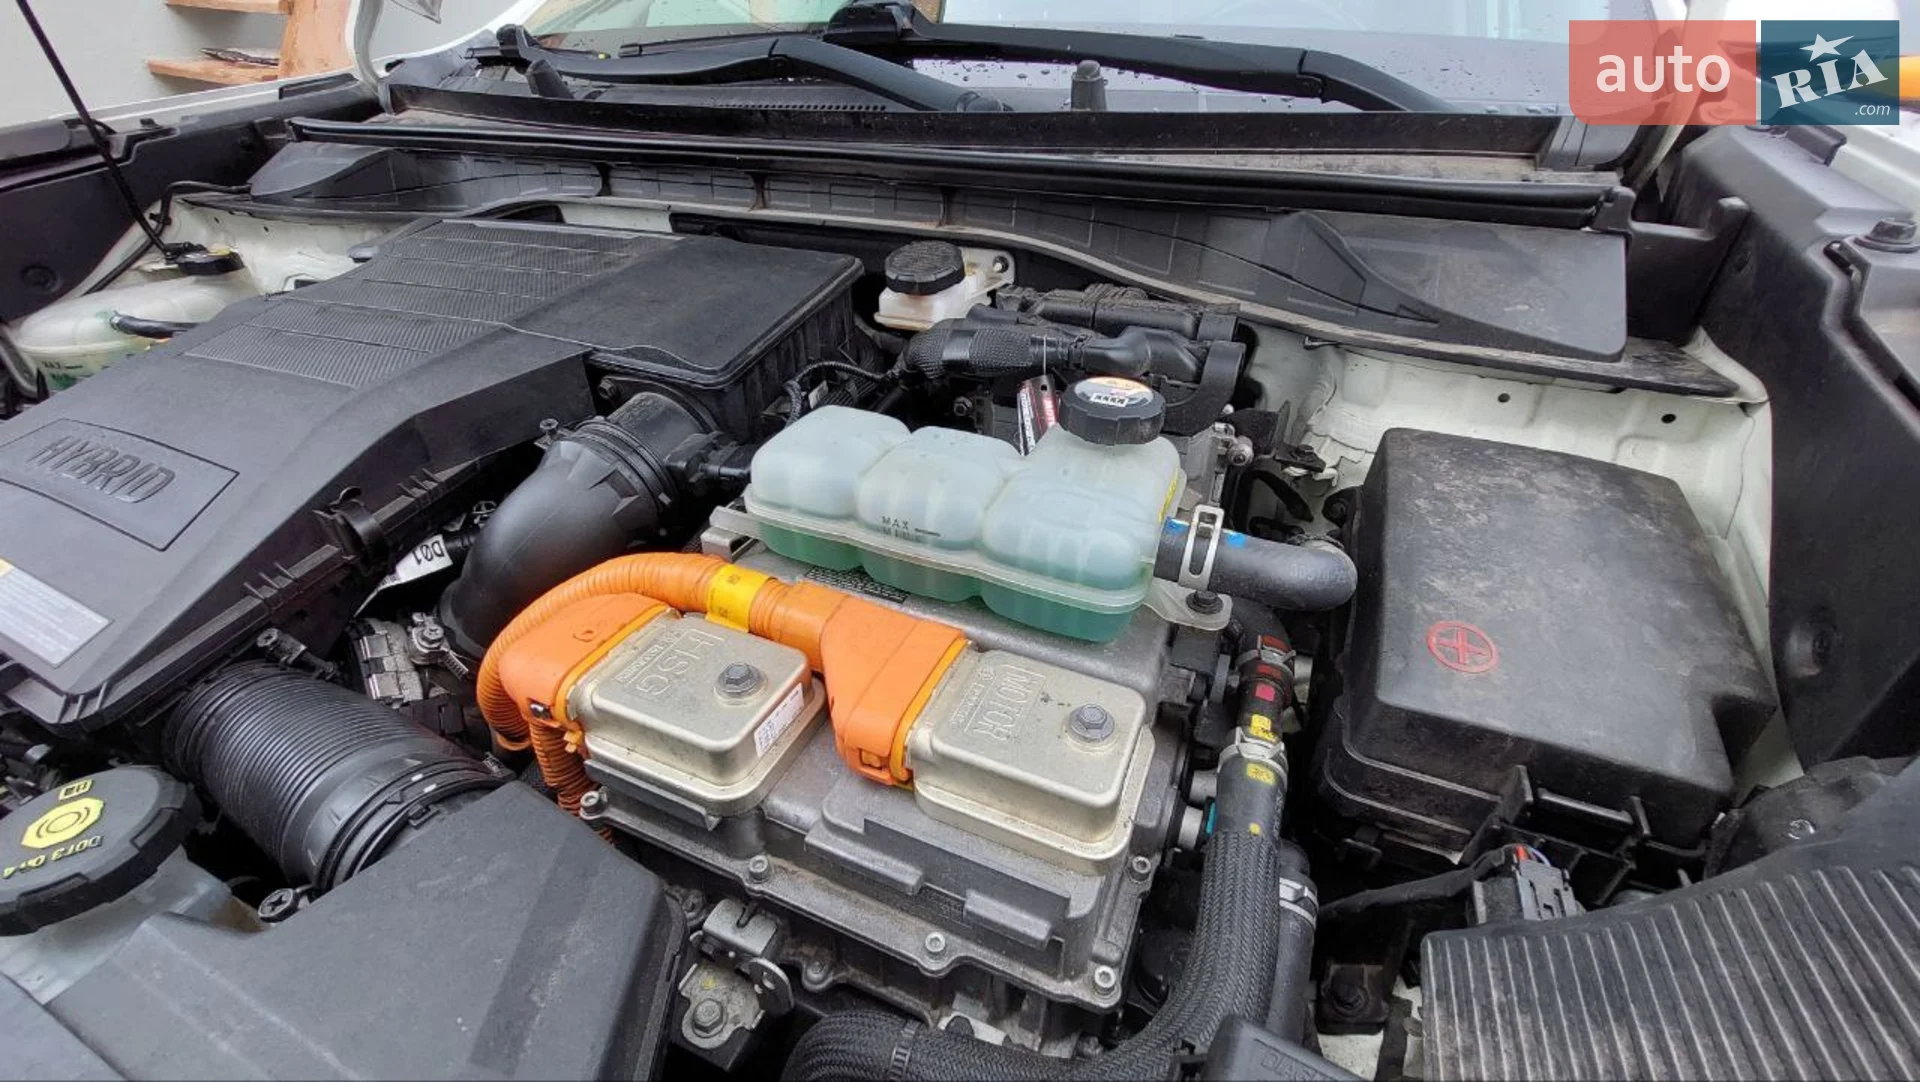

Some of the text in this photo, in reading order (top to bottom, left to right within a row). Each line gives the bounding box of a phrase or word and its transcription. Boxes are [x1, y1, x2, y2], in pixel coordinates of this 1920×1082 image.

[27, 435, 176, 504] HYBRID
[881, 515, 909, 530] MAX
[635, 635, 716, 696] HSG
[973, 671, 1039, 741] MOTOR
[51, 835, 103, 862] DOT3
